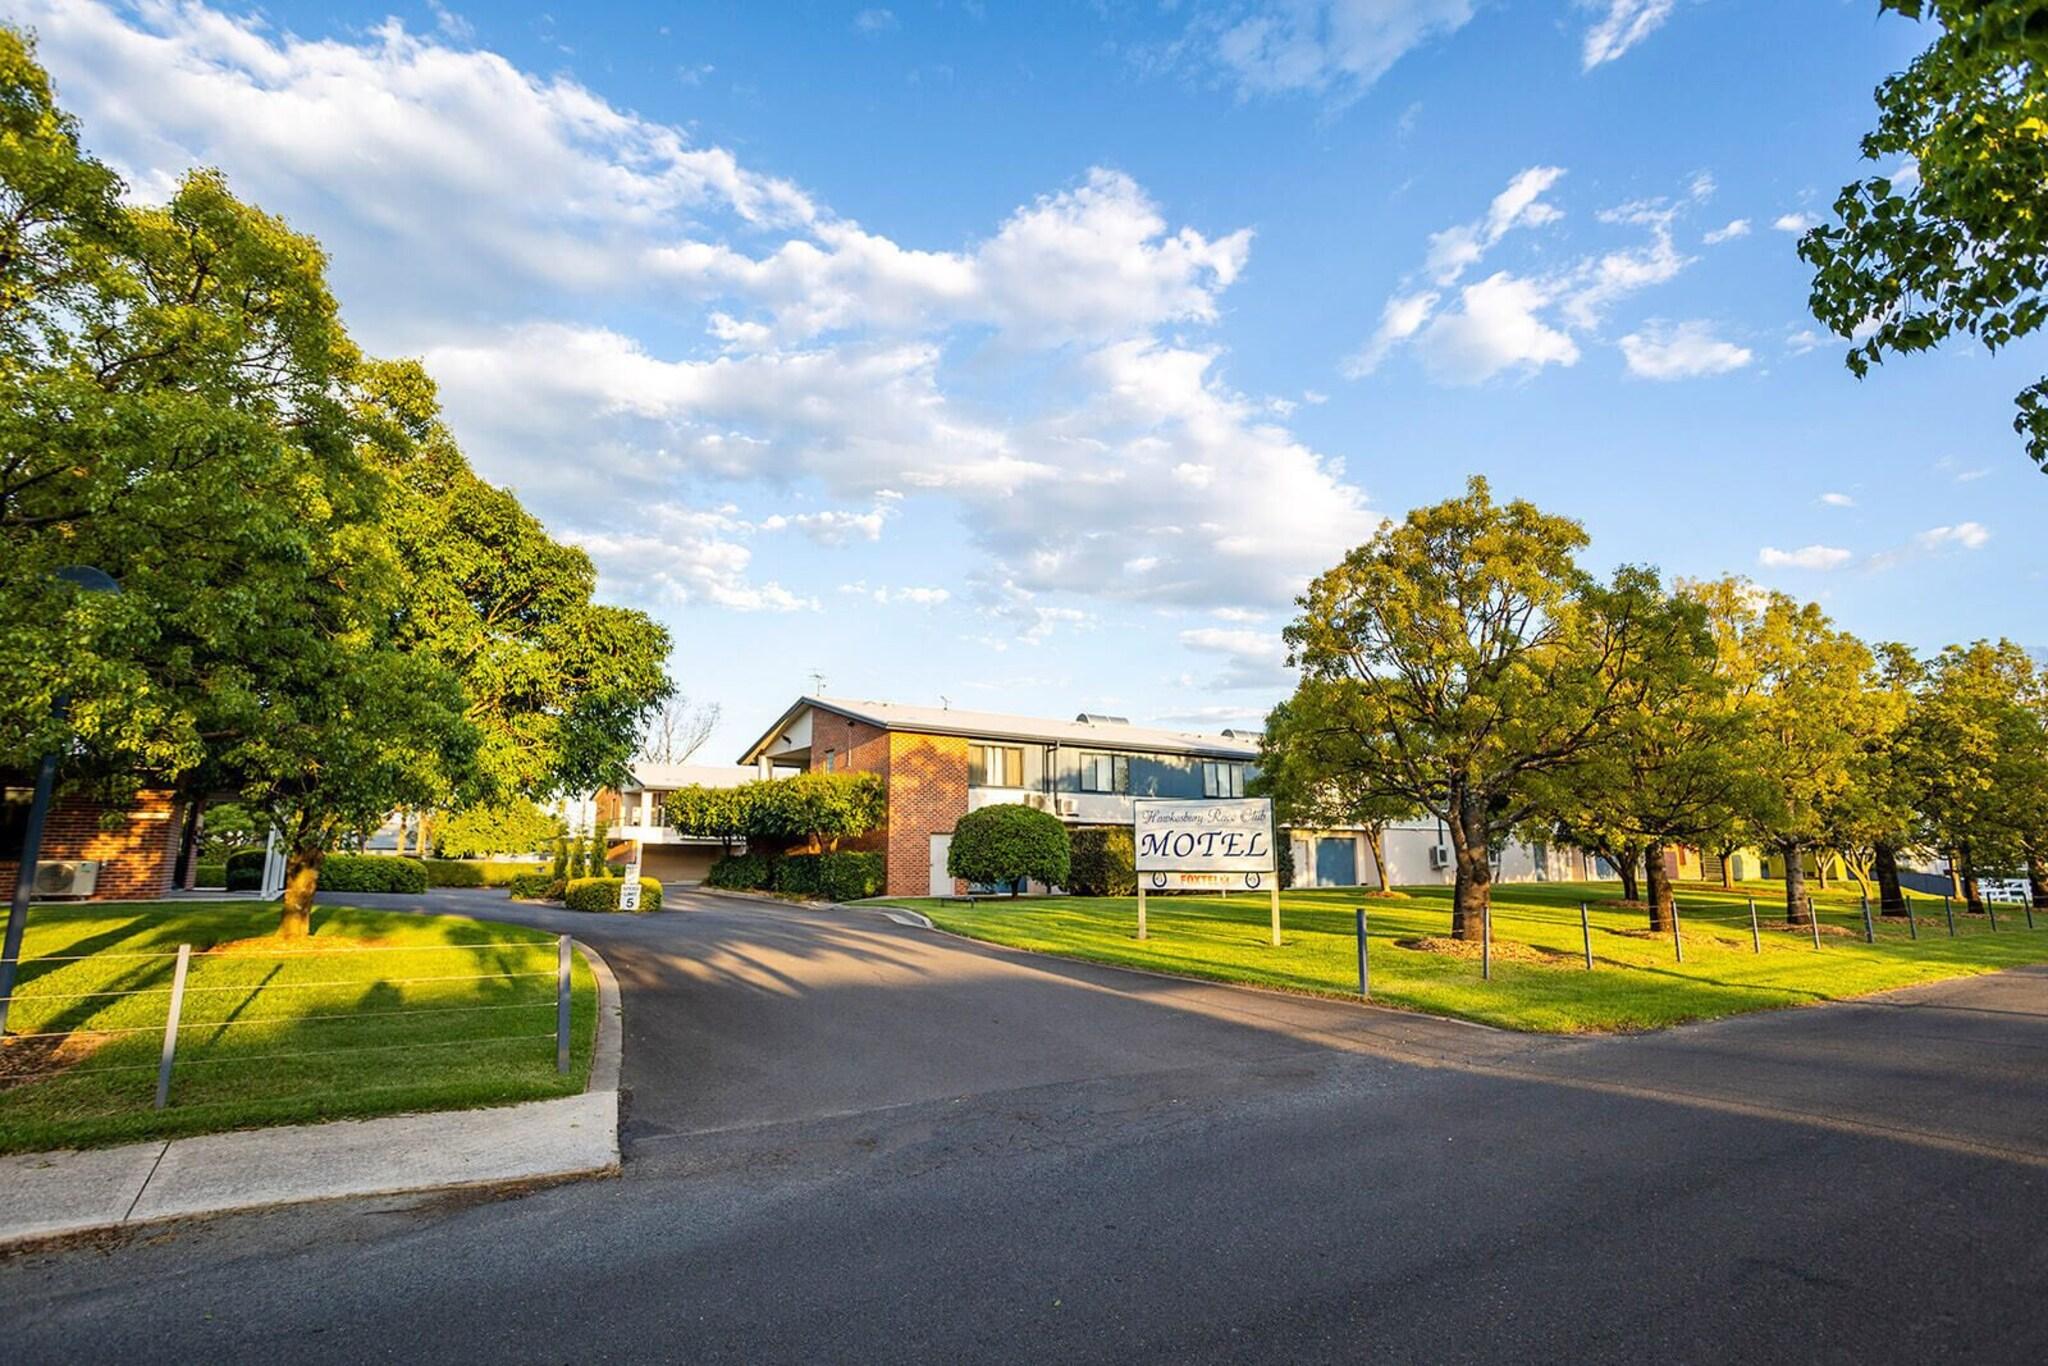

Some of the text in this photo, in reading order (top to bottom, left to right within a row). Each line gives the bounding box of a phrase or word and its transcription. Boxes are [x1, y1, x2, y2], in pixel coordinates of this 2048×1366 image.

[1142, 809, 1204, 825] Hawkesbury
[1240, 808, 1266, 823] Club
[1141, 830, 1268, 857] MOTEL
[1180, 874, 1217, 885] FOXTEL
[626, 898, 634, 908] 5
